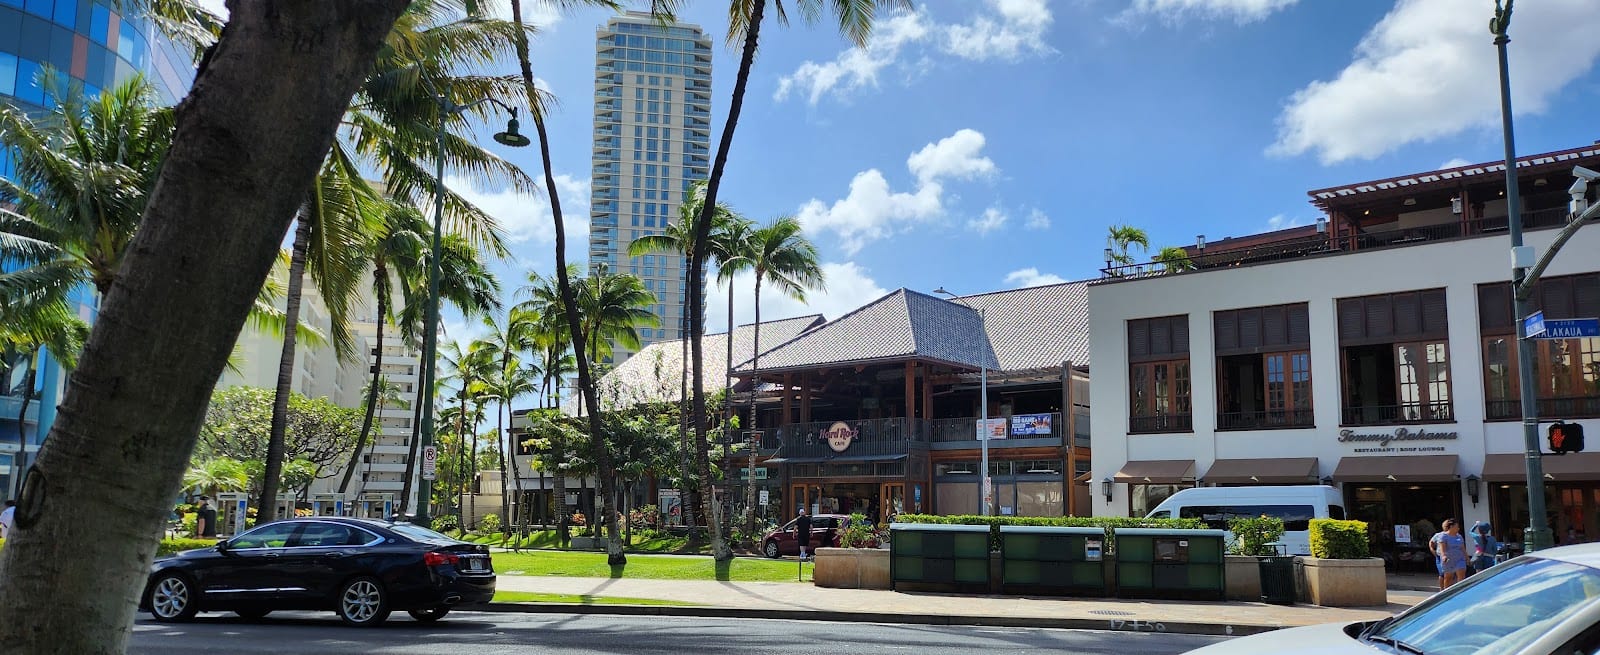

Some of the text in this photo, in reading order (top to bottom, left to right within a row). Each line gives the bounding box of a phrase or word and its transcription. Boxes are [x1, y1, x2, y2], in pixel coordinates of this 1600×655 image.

[819, 427, 860, 441] Hard Rock
[1338, 427, 1458, 447] Tommy Bahama
